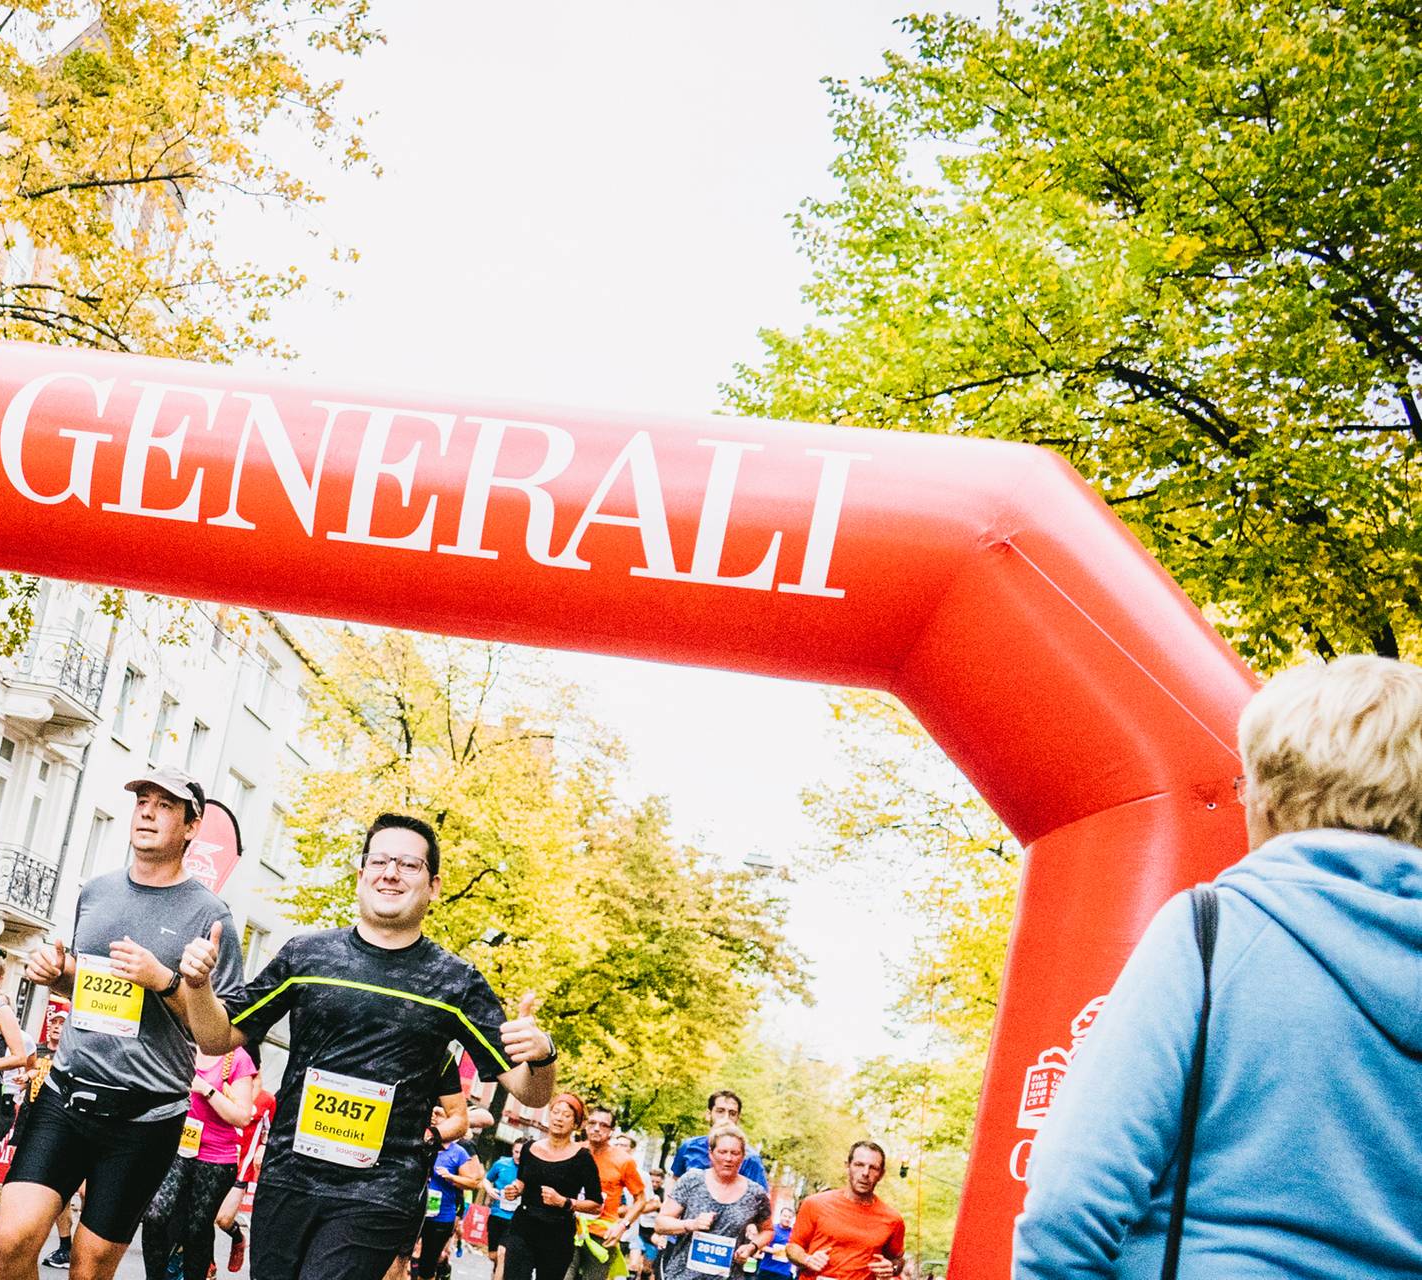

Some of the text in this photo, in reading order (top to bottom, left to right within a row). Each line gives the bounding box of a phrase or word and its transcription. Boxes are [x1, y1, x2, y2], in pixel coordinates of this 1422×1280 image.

[0, 372, 873, 600] GENERALI
[83, 975, 133, 998] 23222
[91, 1000, 118, 1013] David
[314, 1093, 376, 1122] 23457
[314, 1120, 365, 1142] Benedikt
